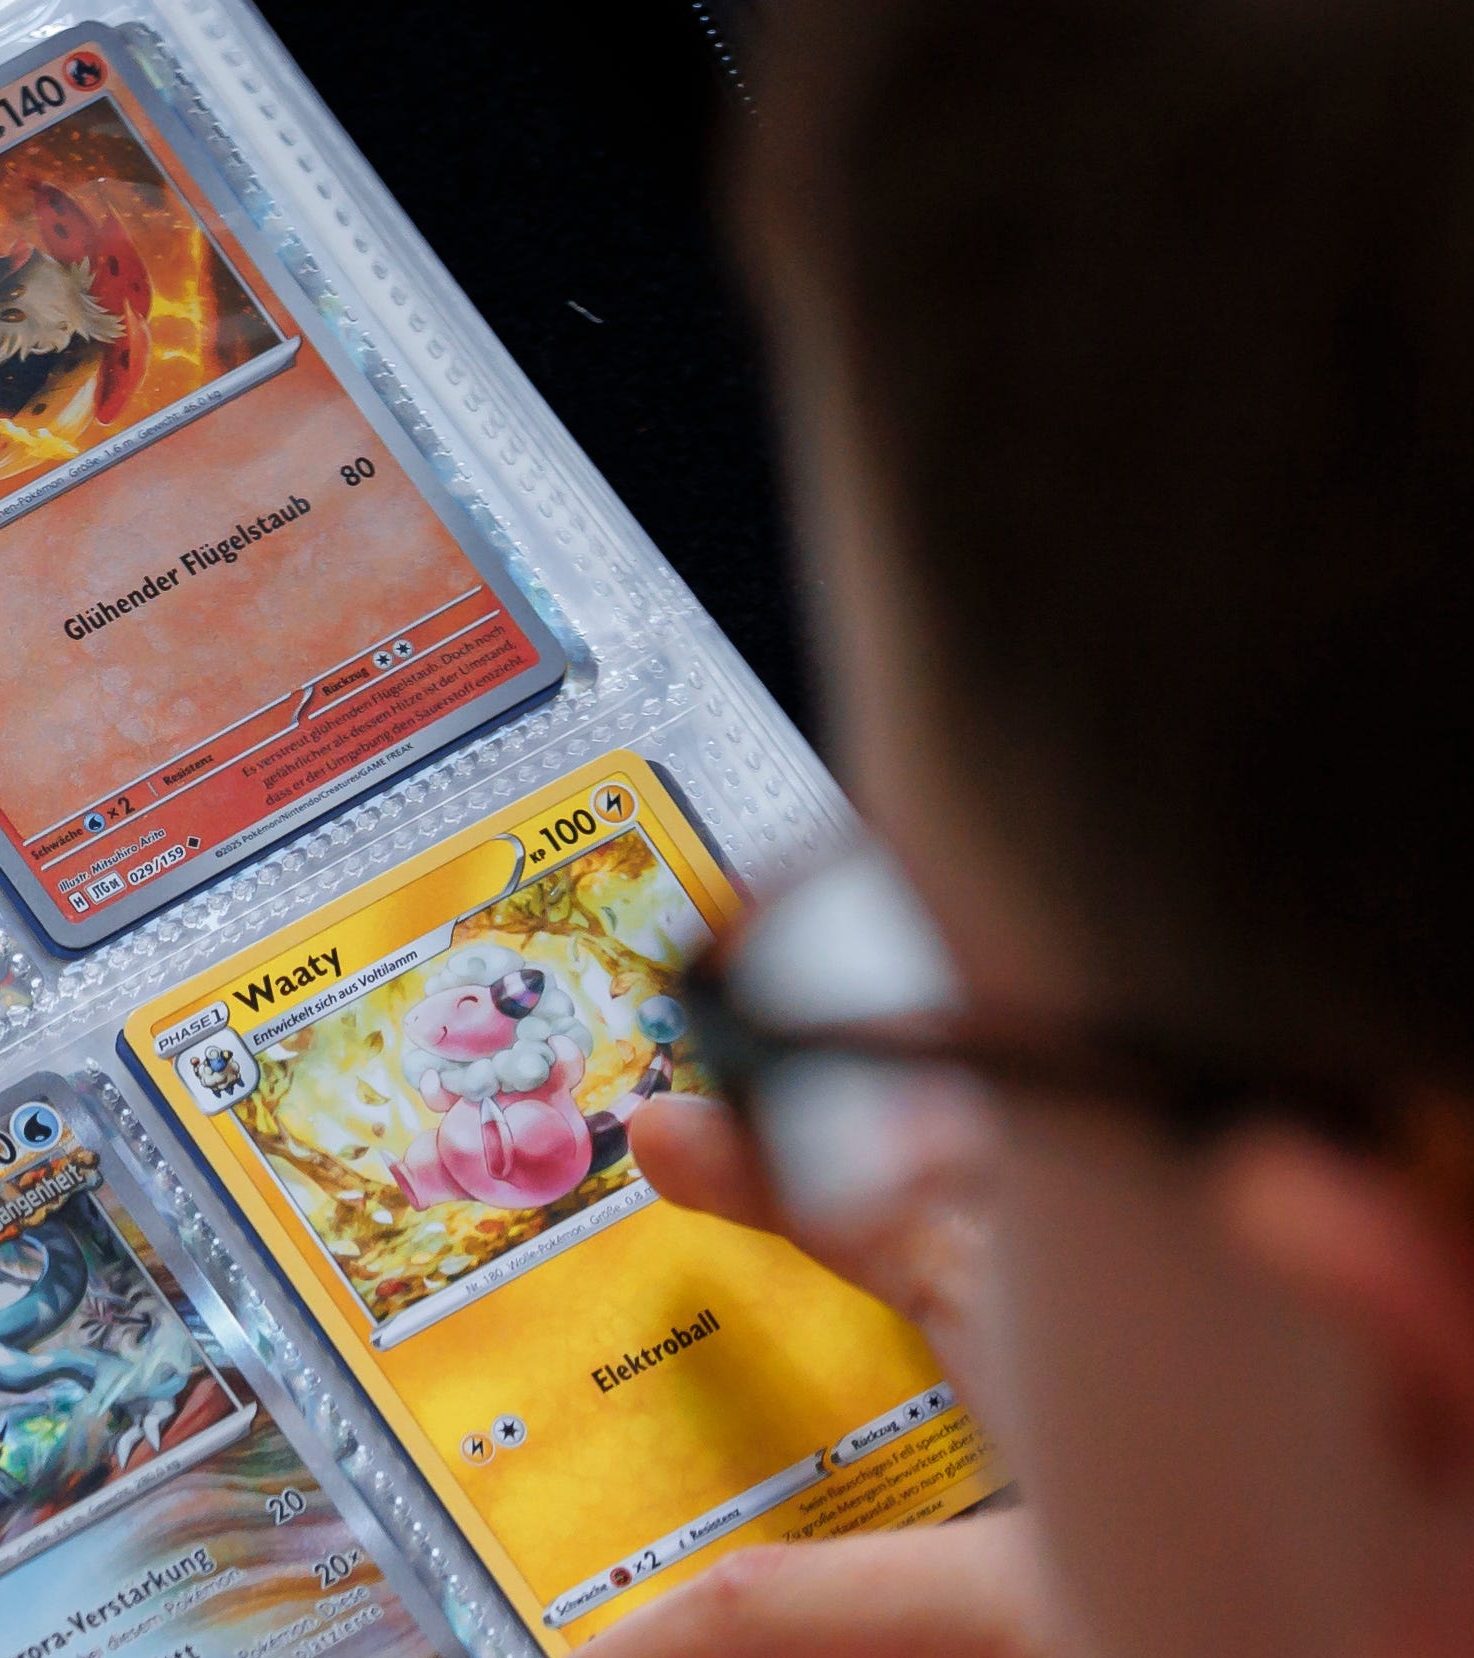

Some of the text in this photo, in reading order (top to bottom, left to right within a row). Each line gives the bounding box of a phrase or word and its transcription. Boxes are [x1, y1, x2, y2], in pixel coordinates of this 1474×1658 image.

[338, 455, 376, 487] 80
[63, 495, 311, 640] Glühender Flügelstaub
[438, 641, 476, 666] Doch
[320, 666, 371, 697] Rückzug
[435, 670, 460, 688] der
[384, 741, 415, 762] FREAK
[161, 753, 215, 786] Resistenz
[29, 827, 84, 861] Schwäche
[538, 808, 597, 852] 100
[53, 822, 170, 897] Illustr. Mitsuhiro Arita
[124, 840, 190, 888] 029/159
[527, 847, 547, 865] KP
[71, 894, 86, 909] H
[84, 875, 113, 903] JTG
[232, 947, 342, 1012] Waaty
[251, 949, 418, 1046] Entwickelt sich aus Voltilamm
[590, 1309, 720, 1393] Elektroball
[850, 1419, 904, 1456] Rückzug
[262, 1482, 311, 1527] 20
[688, 1507, 744, 1544] Resistenz
